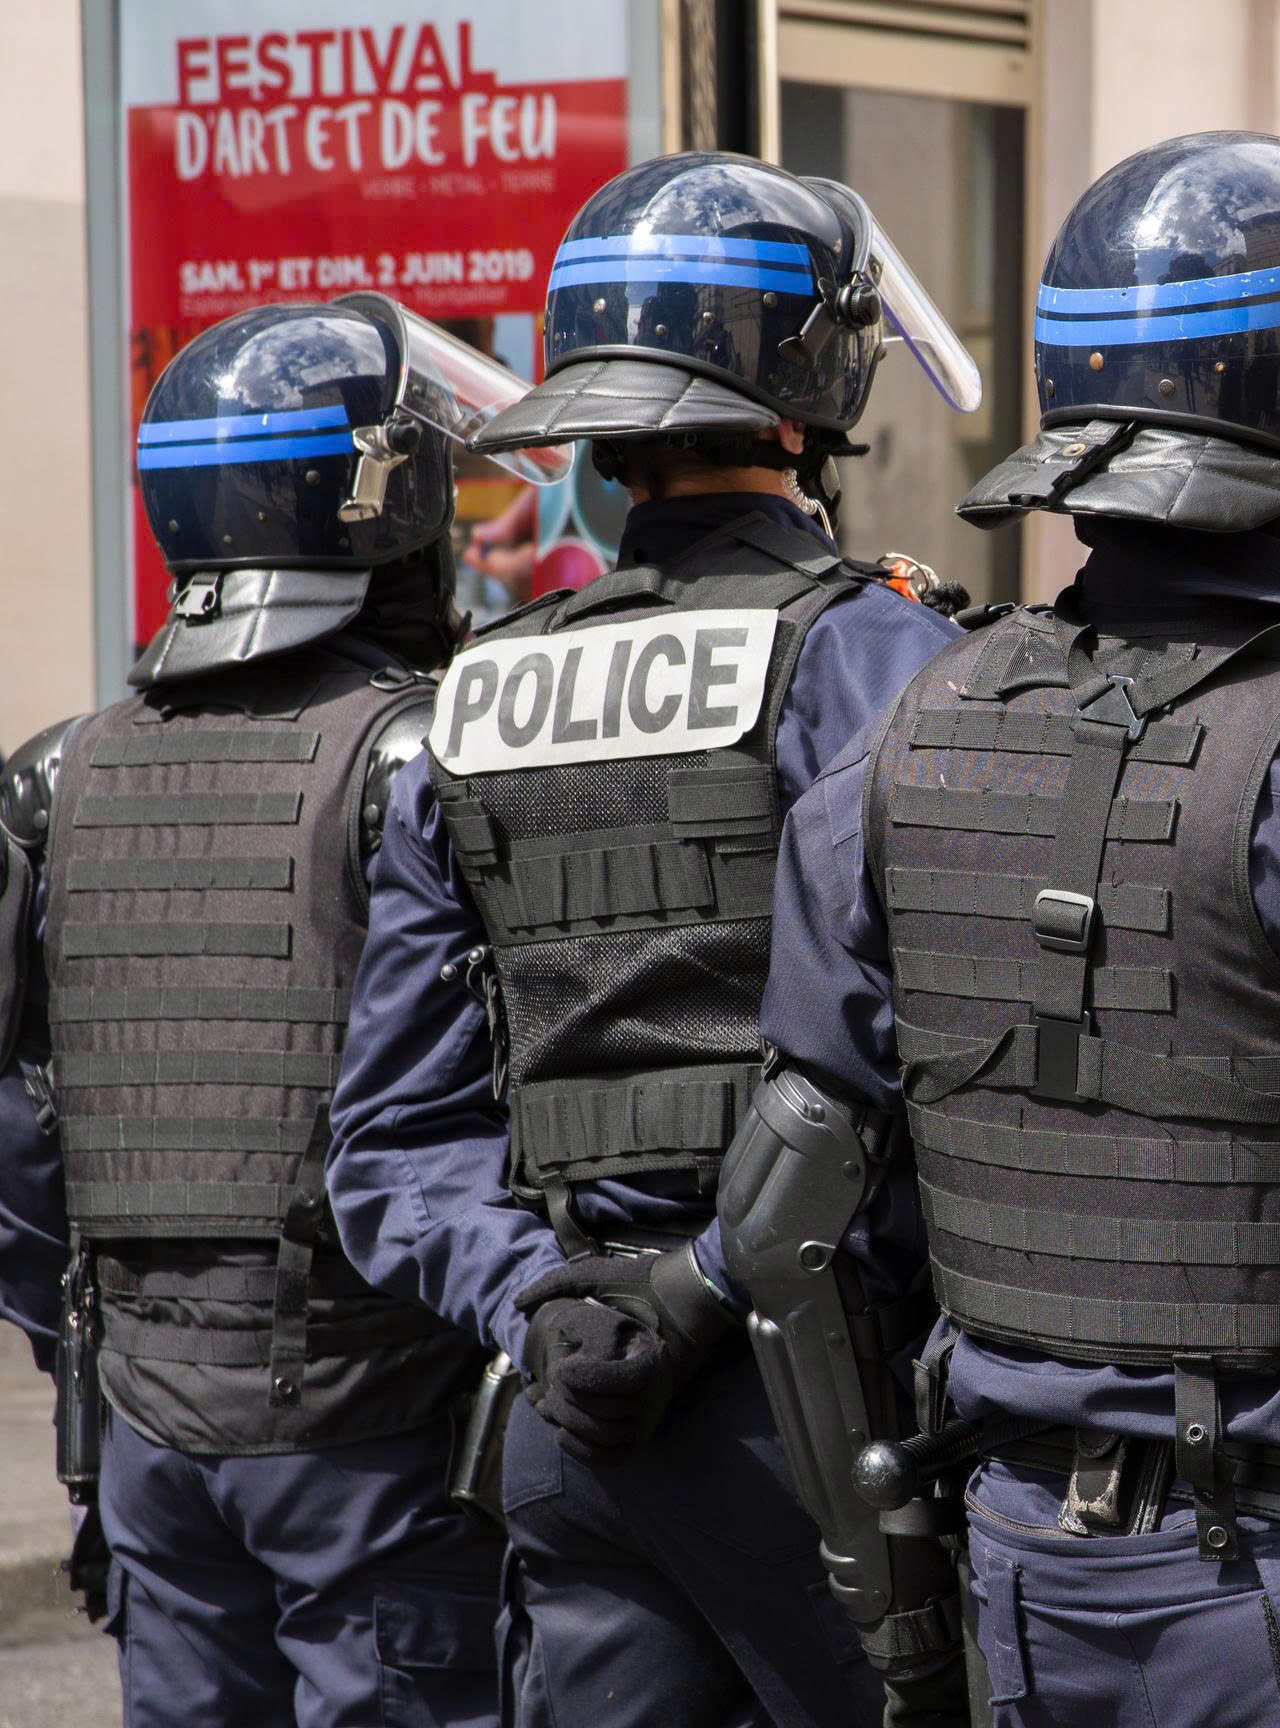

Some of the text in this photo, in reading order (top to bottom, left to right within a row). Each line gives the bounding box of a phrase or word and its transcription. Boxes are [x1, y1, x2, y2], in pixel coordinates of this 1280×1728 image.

[176, 20, 497, 105] FESTIVAL
[175, 92, 558, 181] D'ART ET DE FEU
[178, 259, 246, 294] SAM.
[278, 256, 312, 290] ET
[316, 254, 373, 288] DIM.
[377, 252, 397, 287] 2
[401, 250, 464, 286] JUIN
[467, 247, 535, 283] 2019
[443, 627, 749, 758] POLICE
